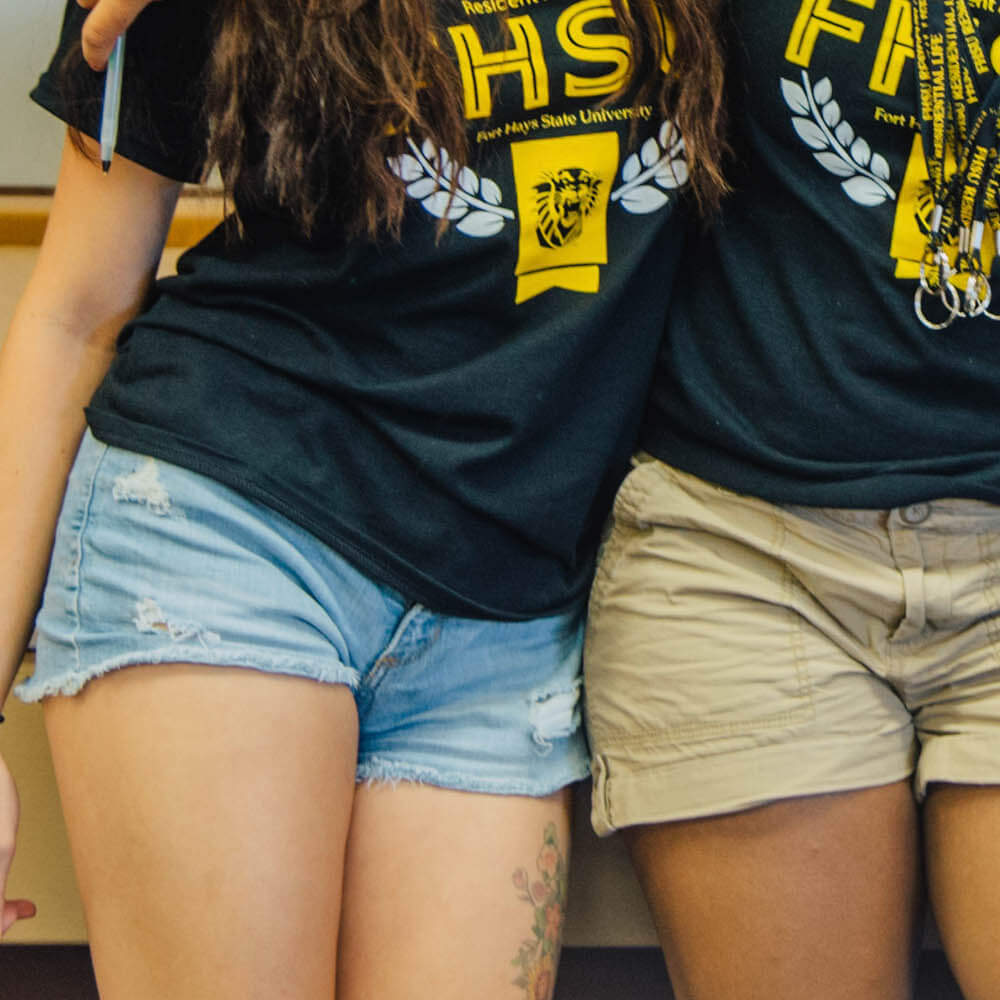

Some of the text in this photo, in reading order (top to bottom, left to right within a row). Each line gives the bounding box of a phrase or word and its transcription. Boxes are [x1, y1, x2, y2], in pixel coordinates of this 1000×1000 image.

[930, 34, 943, 64] LIFE
[943, 8, 962, 100] RESIDENTIAL
[966, 35, 988, 74] FHSU
[540, 113, 578, 130] State
[932, 67, 946, 157] RESIDENTIAL
[966, 145, 988, 184] FHSU
